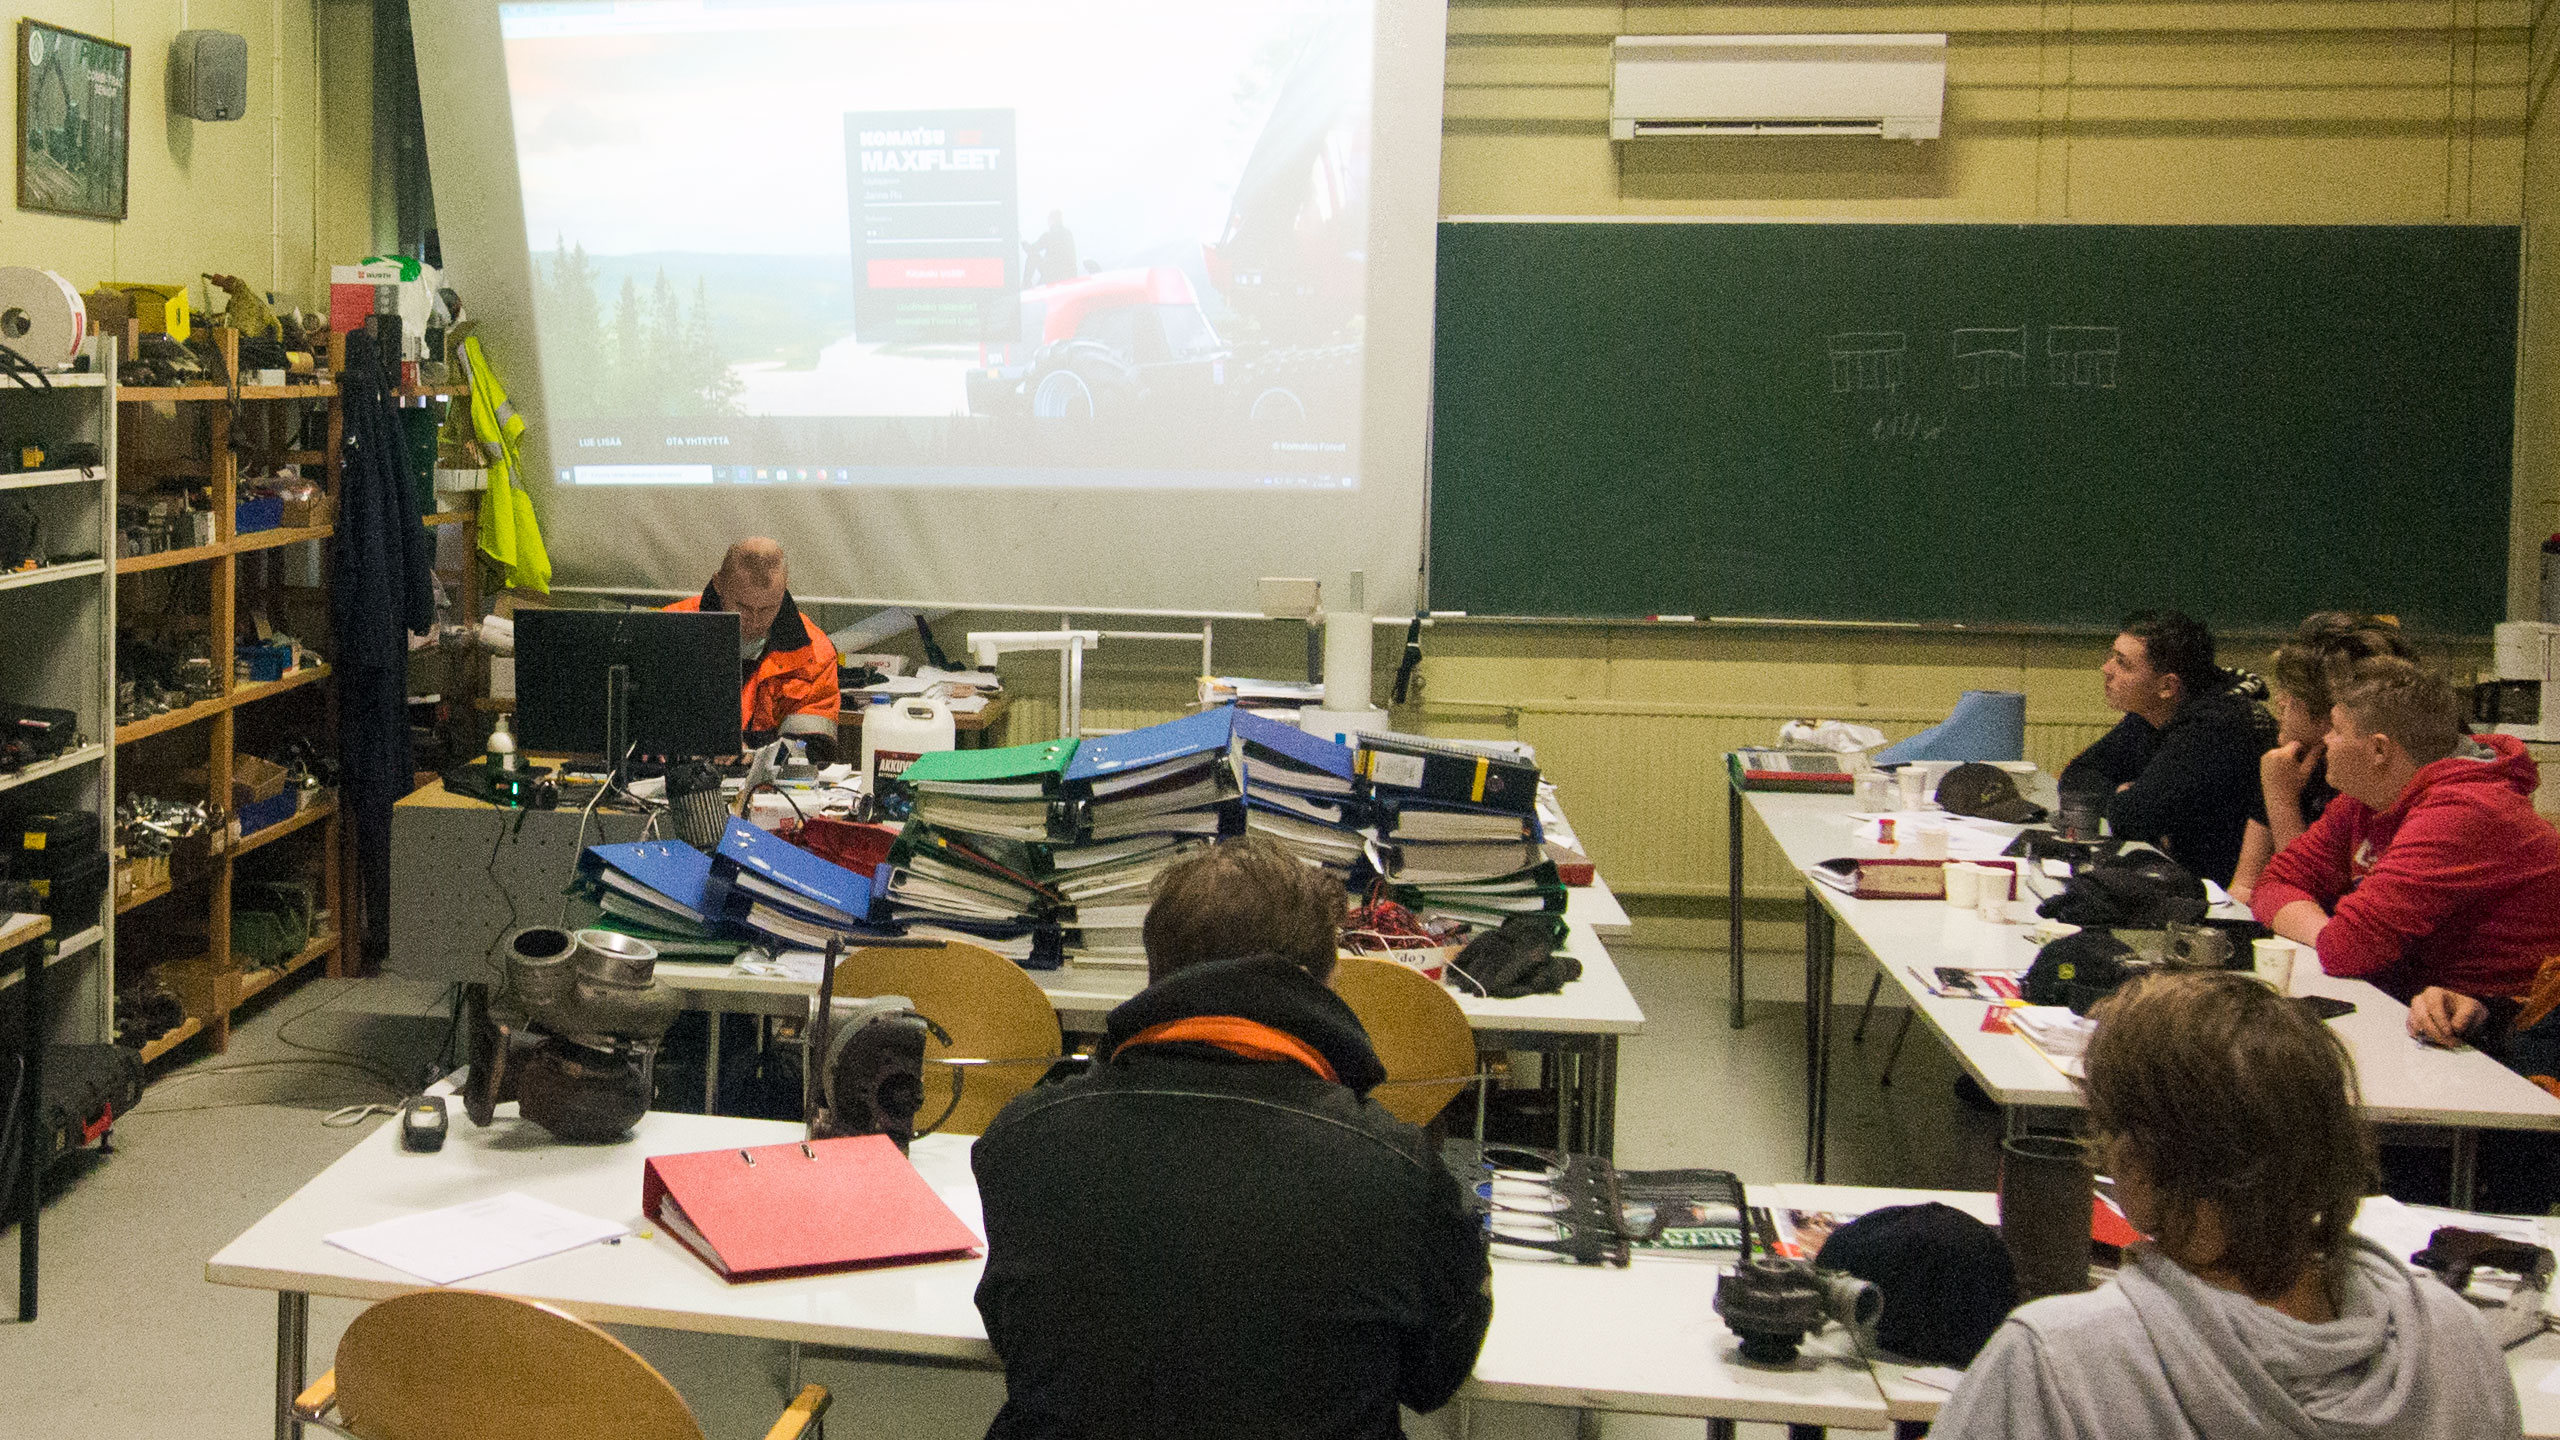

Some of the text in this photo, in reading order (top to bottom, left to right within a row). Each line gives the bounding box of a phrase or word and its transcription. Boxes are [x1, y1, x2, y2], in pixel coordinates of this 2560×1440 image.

[859, 127, 945, 147] KOMATSU
[861, 148, 1000, 172] MAXIFLEET
[579, 437, 595, 447] LUE
[666, 436, 684, 447] OTA
